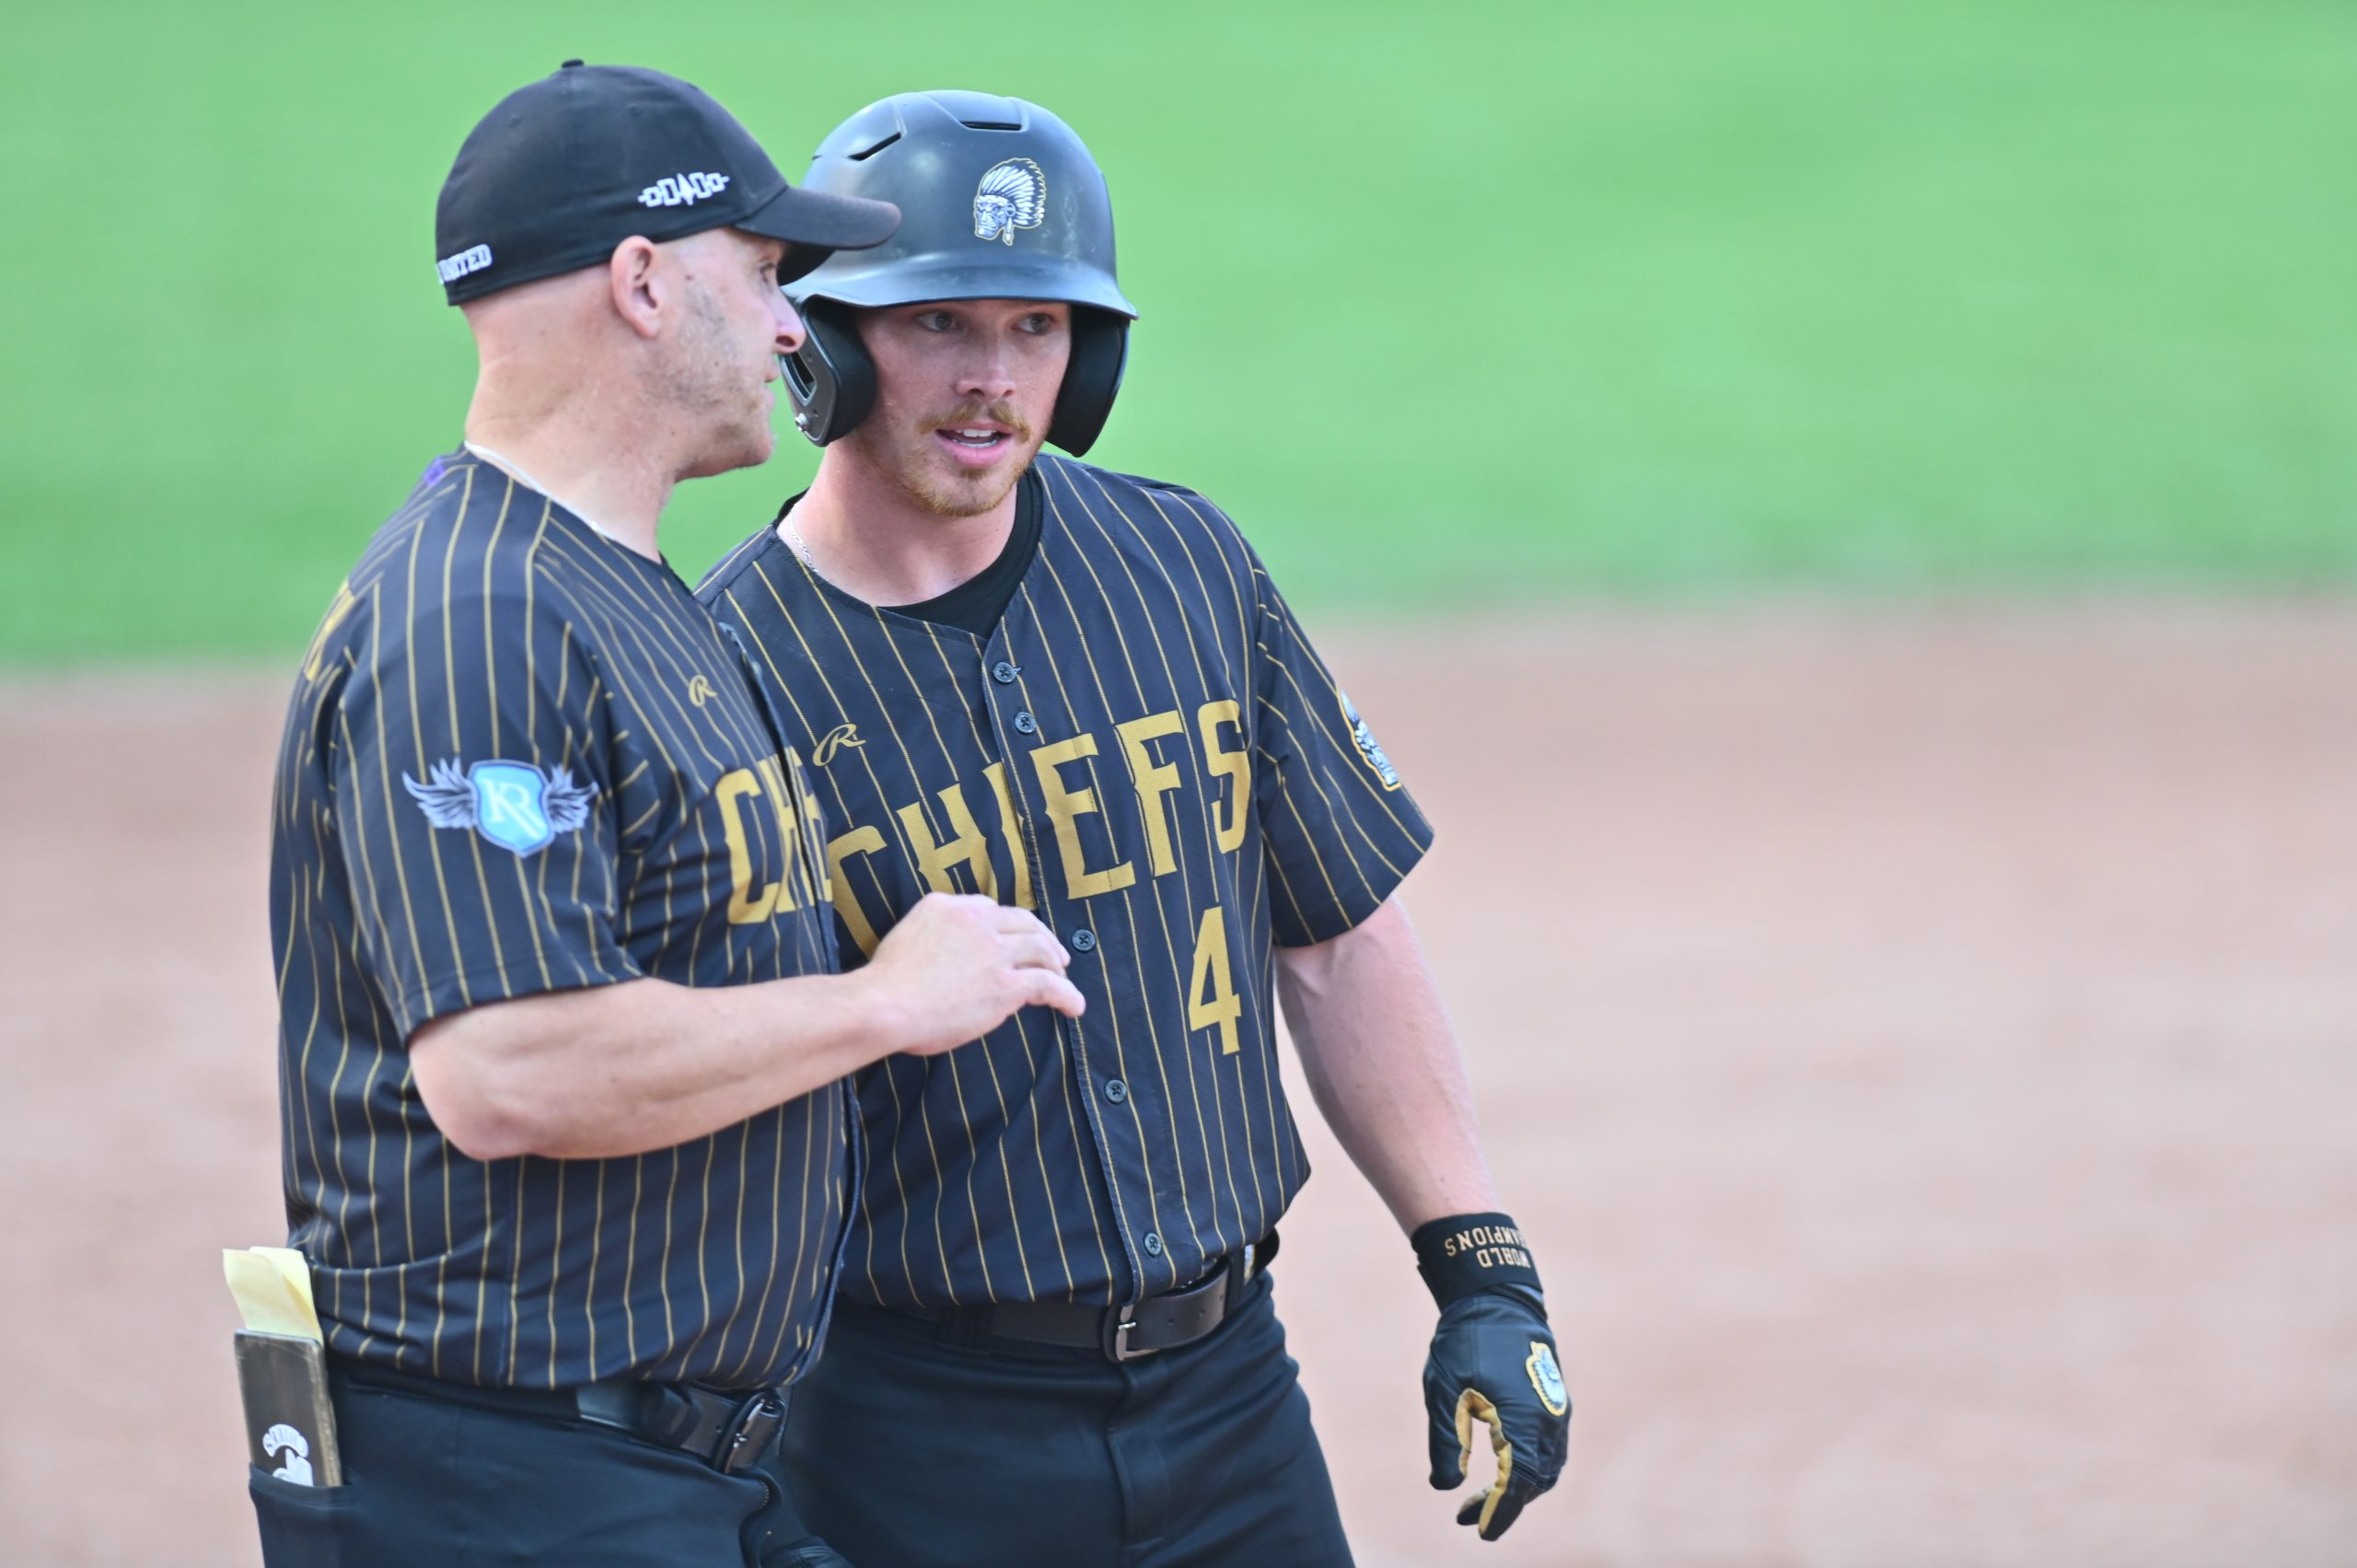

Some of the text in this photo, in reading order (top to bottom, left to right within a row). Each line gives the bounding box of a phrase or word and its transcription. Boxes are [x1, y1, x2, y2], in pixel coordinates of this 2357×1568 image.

[812, 723, 866, 767] R
[1189, 905, 1242, 1056] 4
[1476, 1247, 1531, 1269] WORLD
